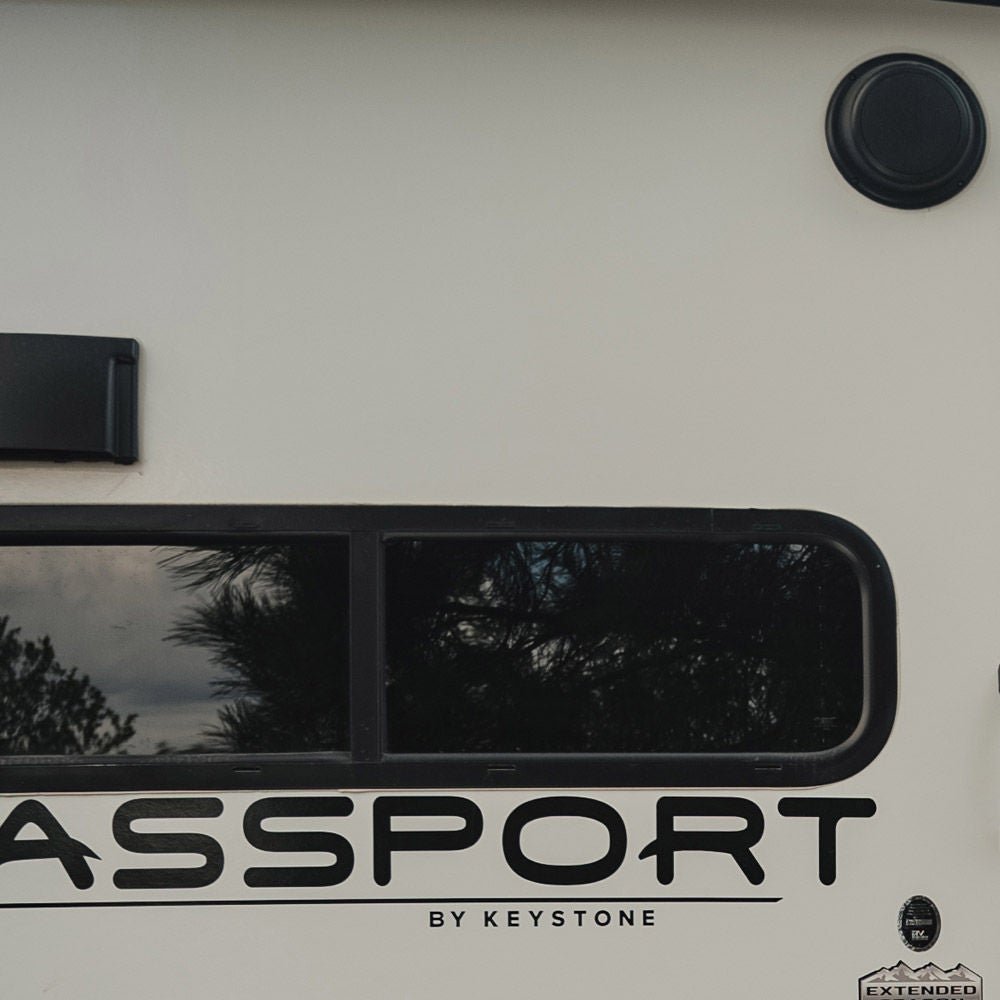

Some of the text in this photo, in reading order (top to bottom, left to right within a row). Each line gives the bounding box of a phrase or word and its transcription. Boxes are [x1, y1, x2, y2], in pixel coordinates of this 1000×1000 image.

[429, 909, 655, 928] BY KEYSTONE
[866, 985, 977, 996] EXTENDED
